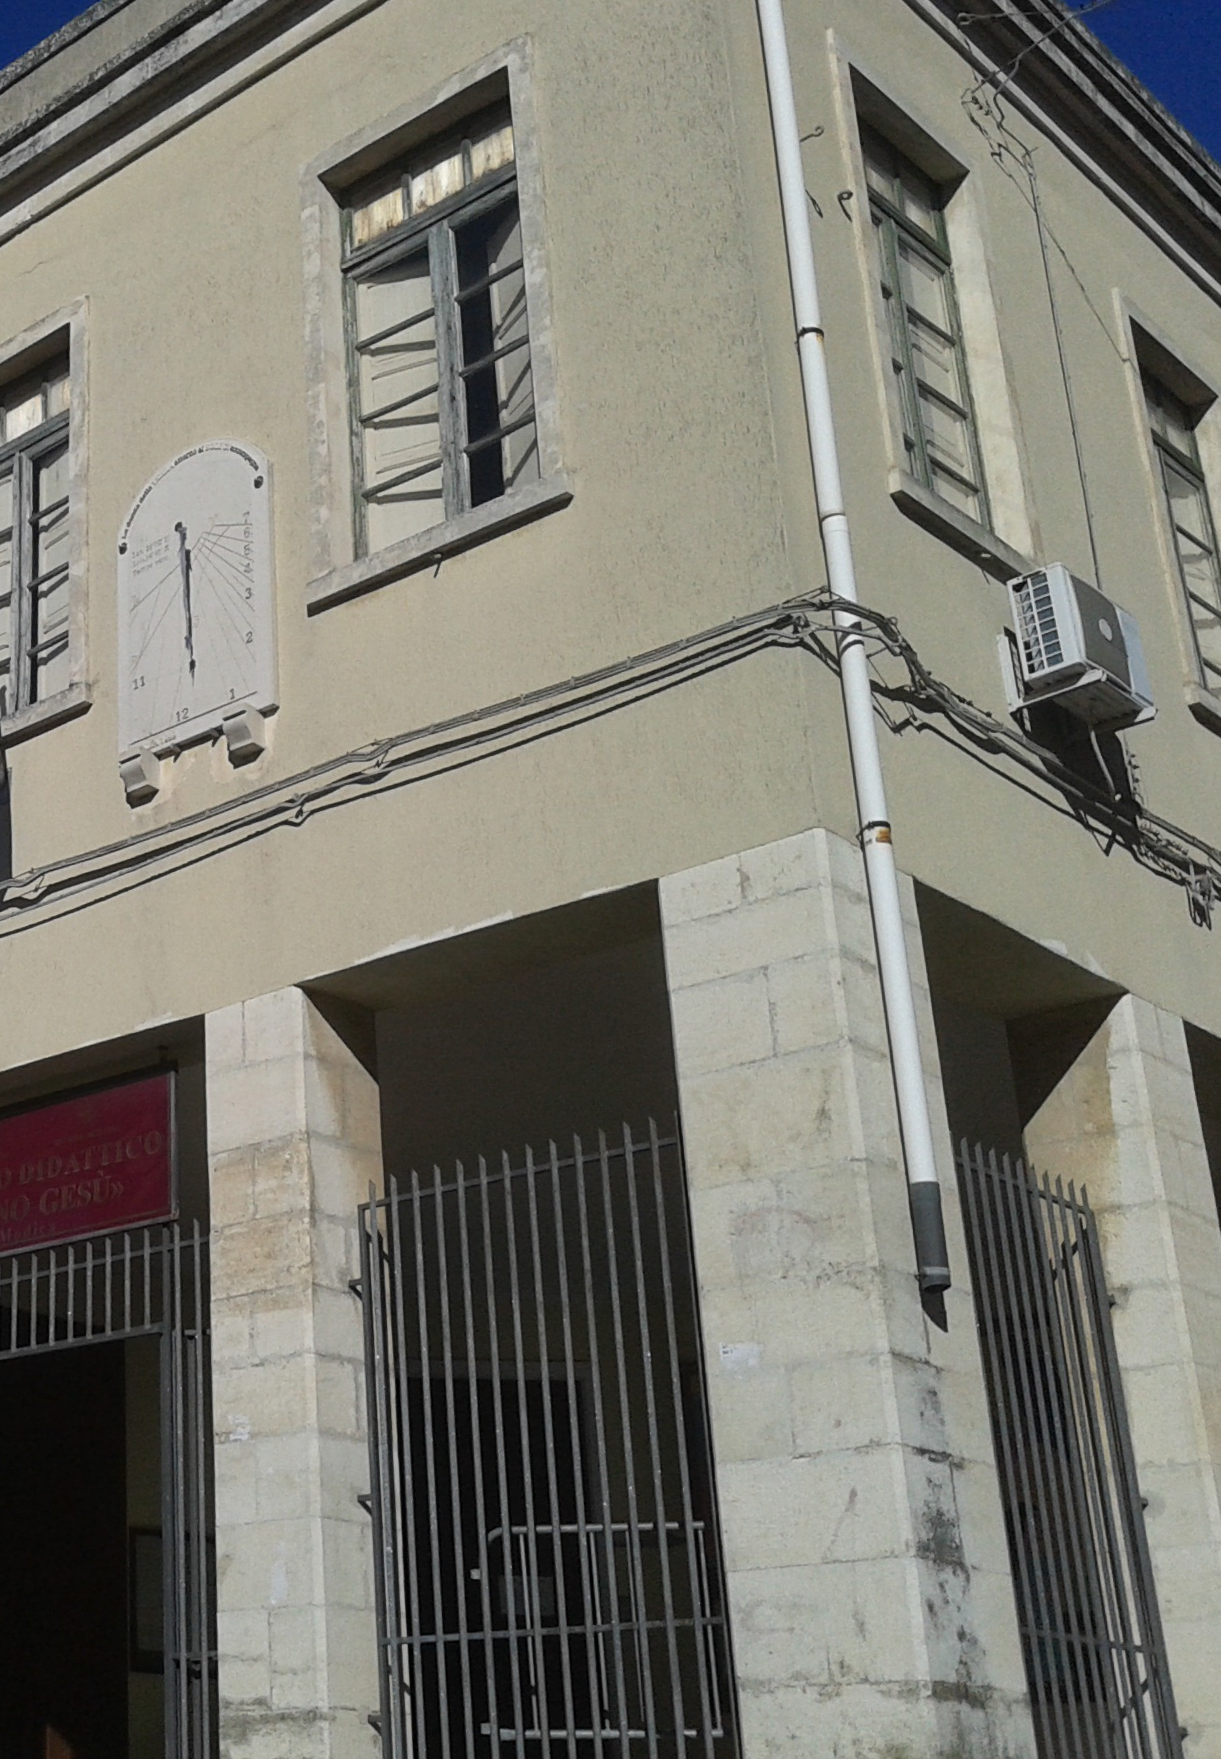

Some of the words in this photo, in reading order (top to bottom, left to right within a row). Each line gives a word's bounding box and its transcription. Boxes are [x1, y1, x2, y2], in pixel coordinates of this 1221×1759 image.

[244, 587, 253, 600] 3
[245, 631, 253, 644] 2
[133, 676, 146, 690] 11
[229, 688, 236, 700] 1
[176, 708, 189, 722] 12
[17, 1130, 163, 1186] DIDATTICO
